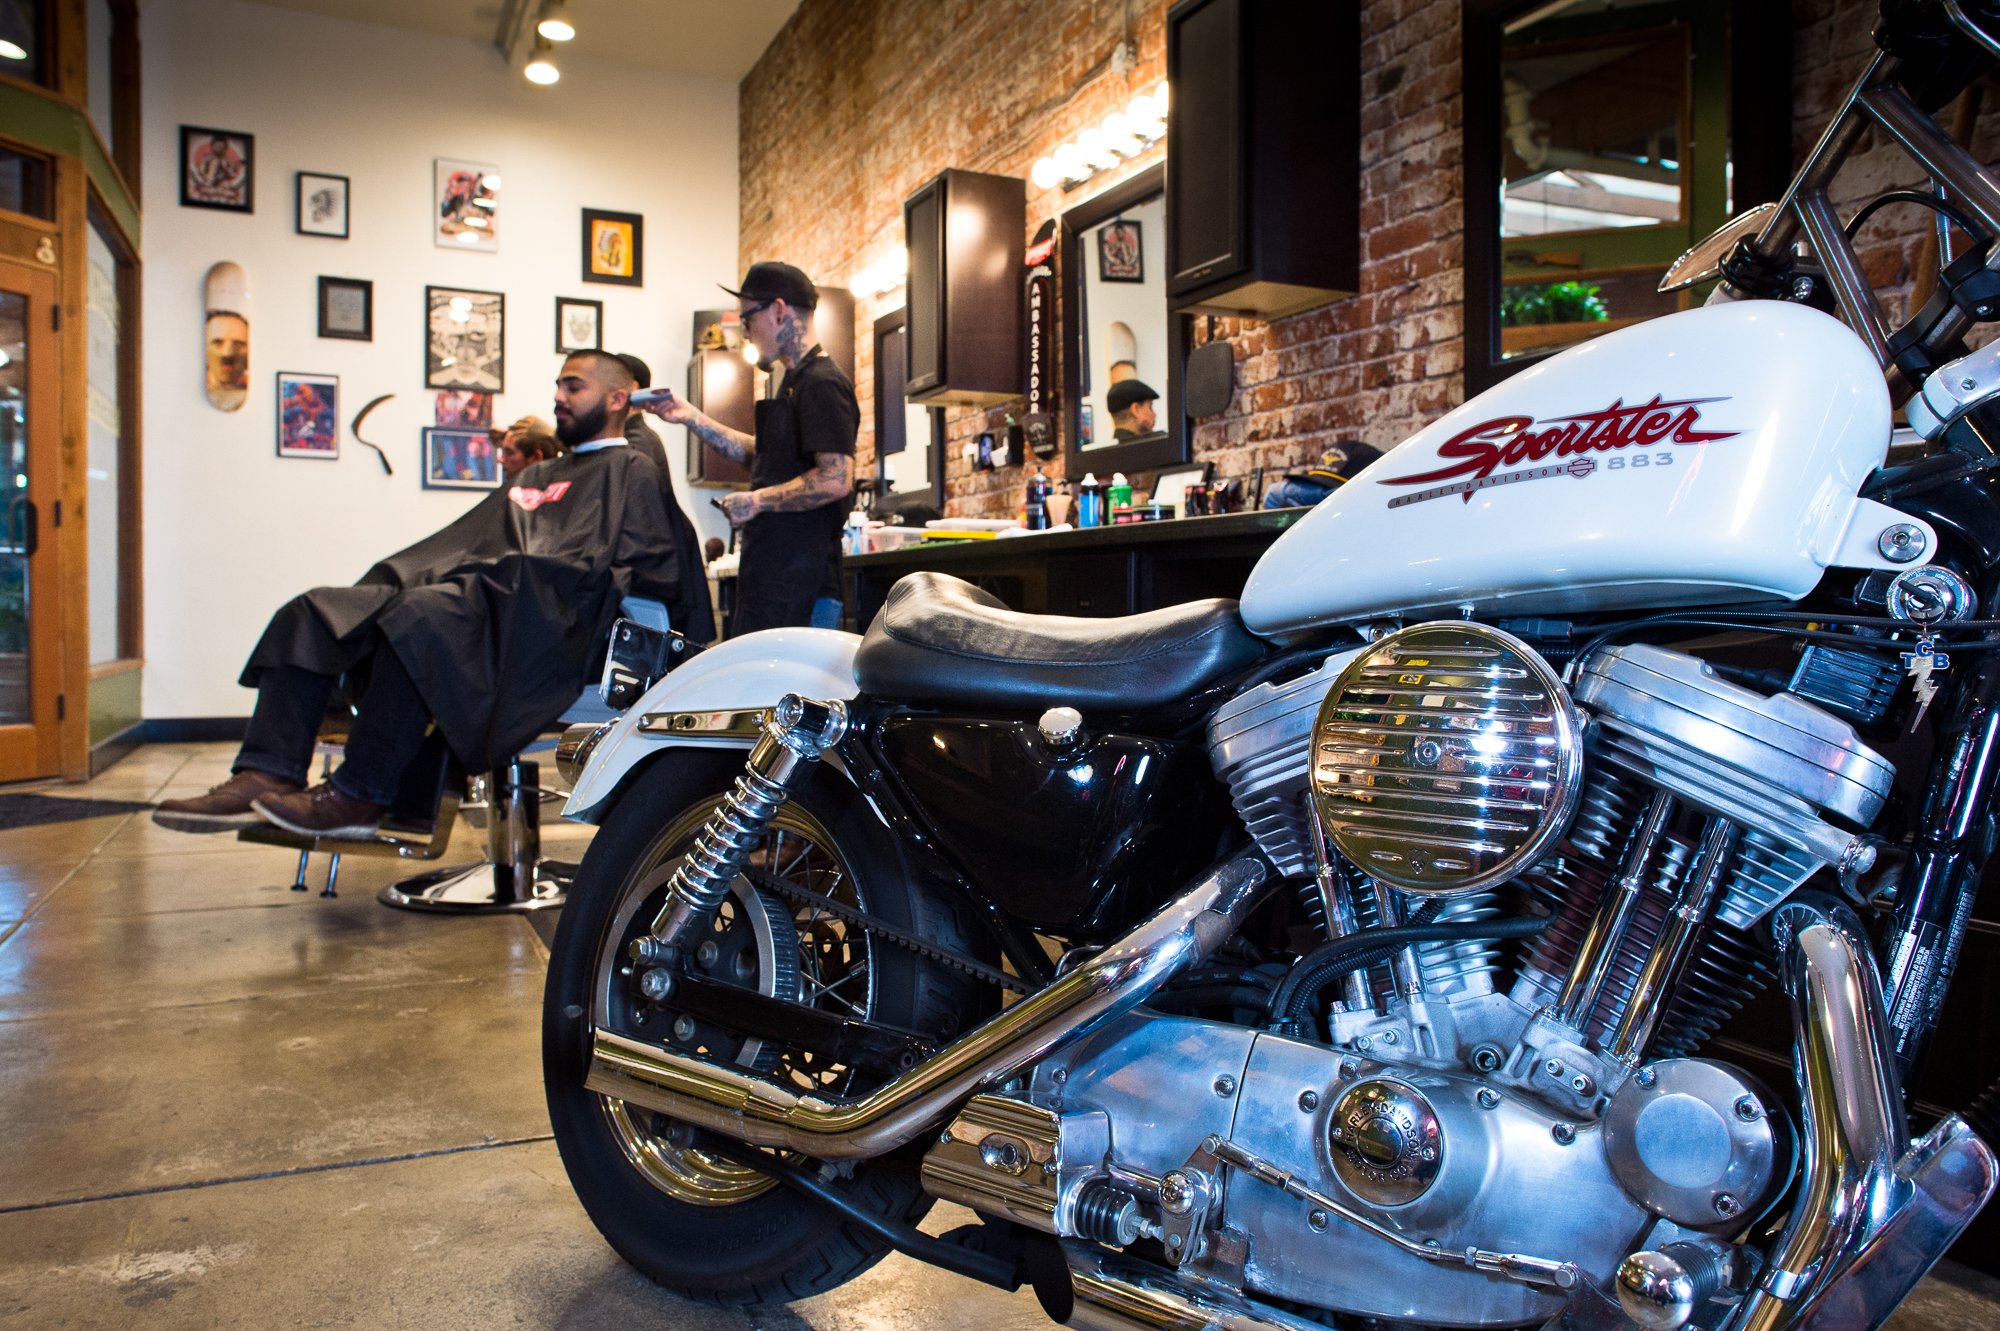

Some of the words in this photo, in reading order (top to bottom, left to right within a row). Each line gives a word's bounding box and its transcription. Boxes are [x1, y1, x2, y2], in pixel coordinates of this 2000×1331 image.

[1030, 283, 1042, 415] AMBASSADOR
[1376, 392, 1742, 505] Sportster
[1607, 452, 1674, 471] 883
[1394, 466, 1564, 508] HARLEY-DAVIDSON
[1920, 948, 1930, 965] VEHICLE
[1915, 965, 1924, 980] SAFETY
[1900, 1007, 1909, 1022] EFFECT
[1896, 1038, 1905, 1053] MOTOR
[1345, 1101, 1420, 1161] HARLEY-DAVIDSON
[1346, 1150, 1386, 1183] MOTOR
